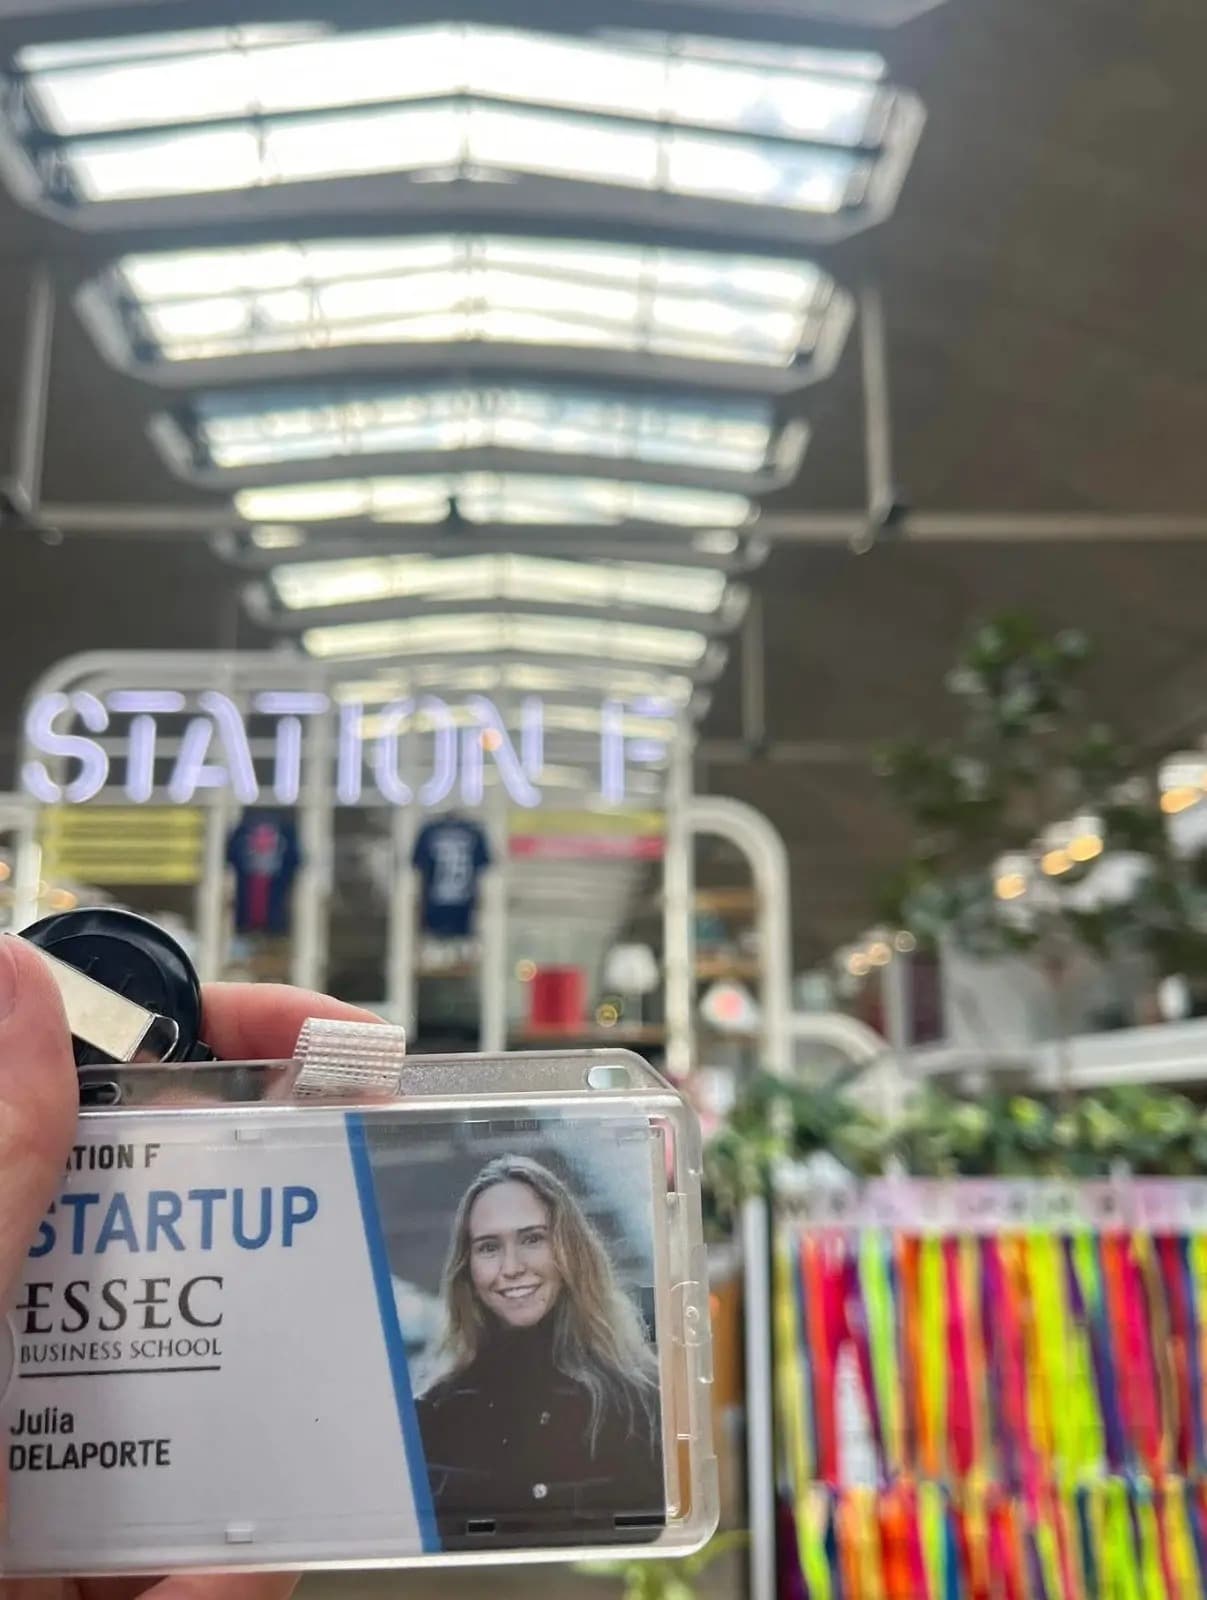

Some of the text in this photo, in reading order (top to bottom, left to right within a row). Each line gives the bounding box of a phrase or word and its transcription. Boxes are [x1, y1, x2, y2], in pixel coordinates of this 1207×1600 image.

[22, 690, 676, 807] STATION F
[144, 1143, 161, 1168] F
[15, 1275, 224, 1334] ESSEC
[20, 1337, 222, 1364] BUSINESS SCHOOL
[10, 1407, 74, 1436] Julia
[9, 1439, 171, 1471] DELAPORTE
